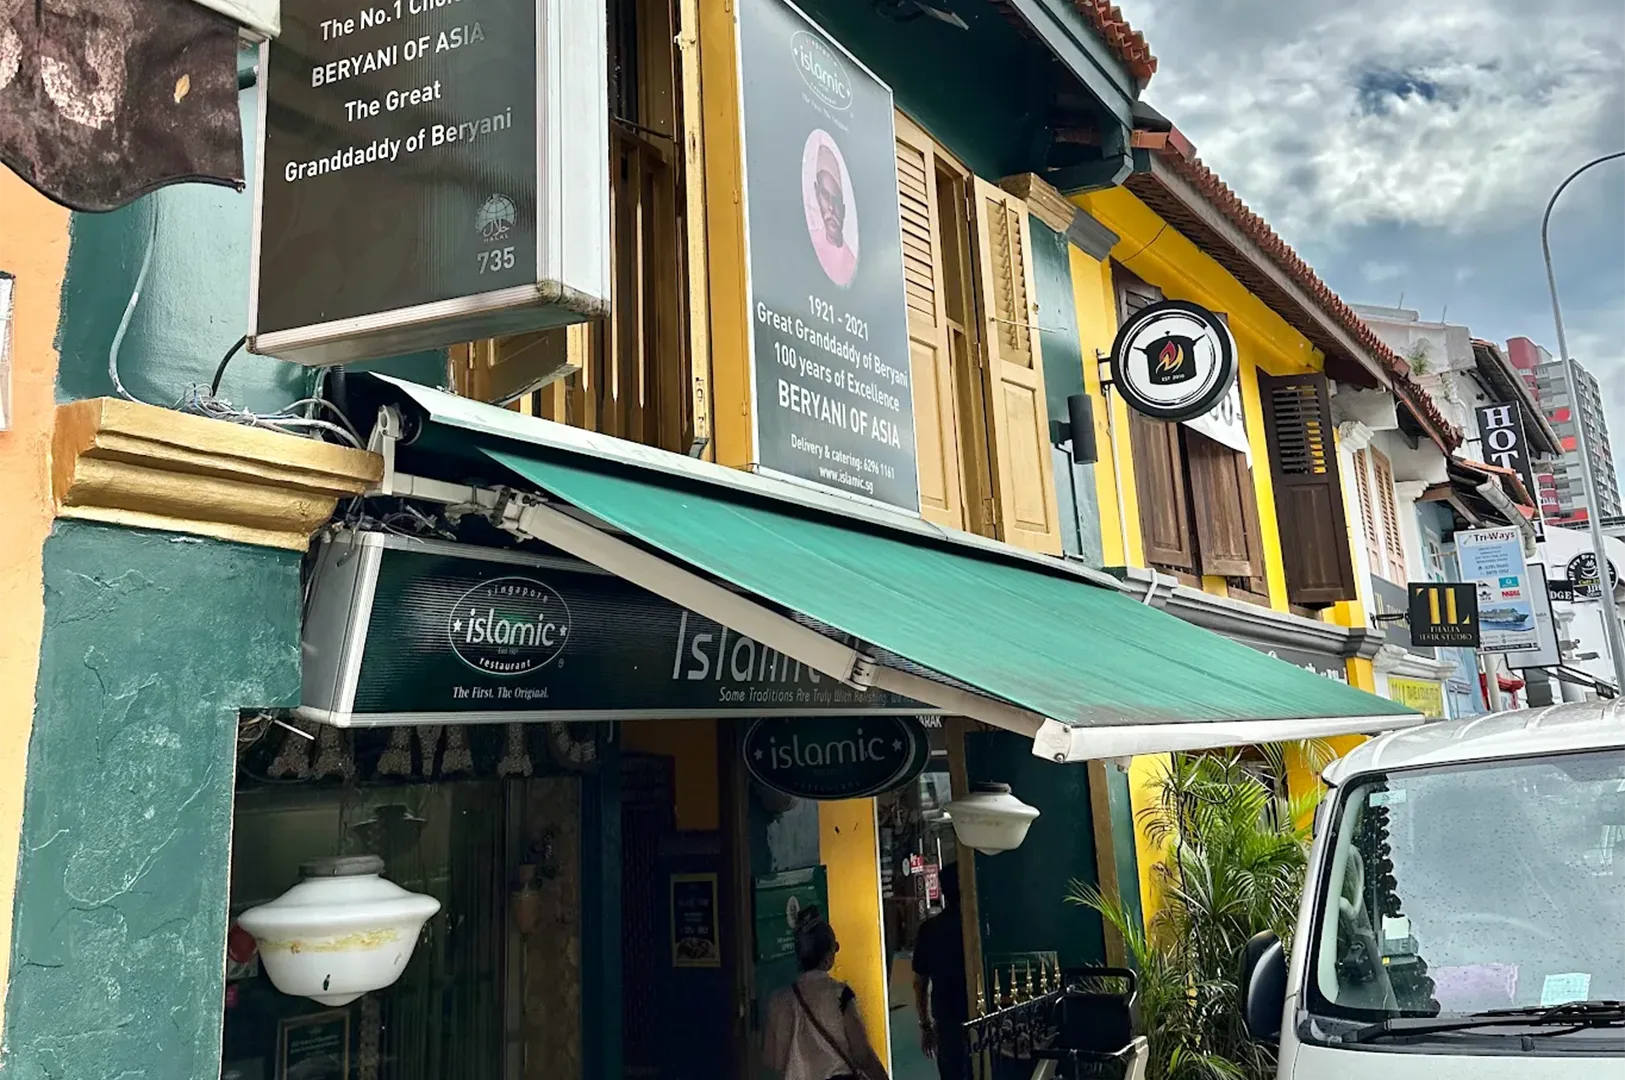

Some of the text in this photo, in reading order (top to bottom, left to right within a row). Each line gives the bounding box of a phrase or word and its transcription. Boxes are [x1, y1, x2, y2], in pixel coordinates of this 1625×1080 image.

[320, 21, 354, 41] The
[311, 22, 485, 88] BERYANI OF ASIA
[800, 45, 846, 99] islamic
[344, 80, 441, 122] The Great
[284, 107, 512, 183] Granddaddy of Beryani
[483, 234, 509, 244] HALAL
[477, 247, 516, 275] 735
[808, 295, 835, 325] 1921
[845, 313, 869, 342] 2021
[757, 301, 908, 388] Great Granddaddy of Beryani
[774, 341, 900, 412] 100 years of Excellence
[778, 379, 901, 450] BERYANI OF ASIA
[791, 433, 824, 459] Delivery
[824, 445, 831, 459] &
[831, 449, 864, 473] catering:
[819, 466, 874, 495] www.islamic.sg
[1473, 531, 1515, 543] Tri-Ways
[487, 585, 549, 603] singapore
[1550, 590, 1572, 600] DGE
[466, 608, 556, 647] islamic
[479, 657, 531, 671] restaurant
[453, 686, 549, 701] The First. The Original.
[719, 686, 746, 702] Some
[749, 687, 794, 702] Traditions
[795, 688, 810, 702] Are
[813, 688, 831, 706] Truly
[770, 729, 886, 770] islamic
